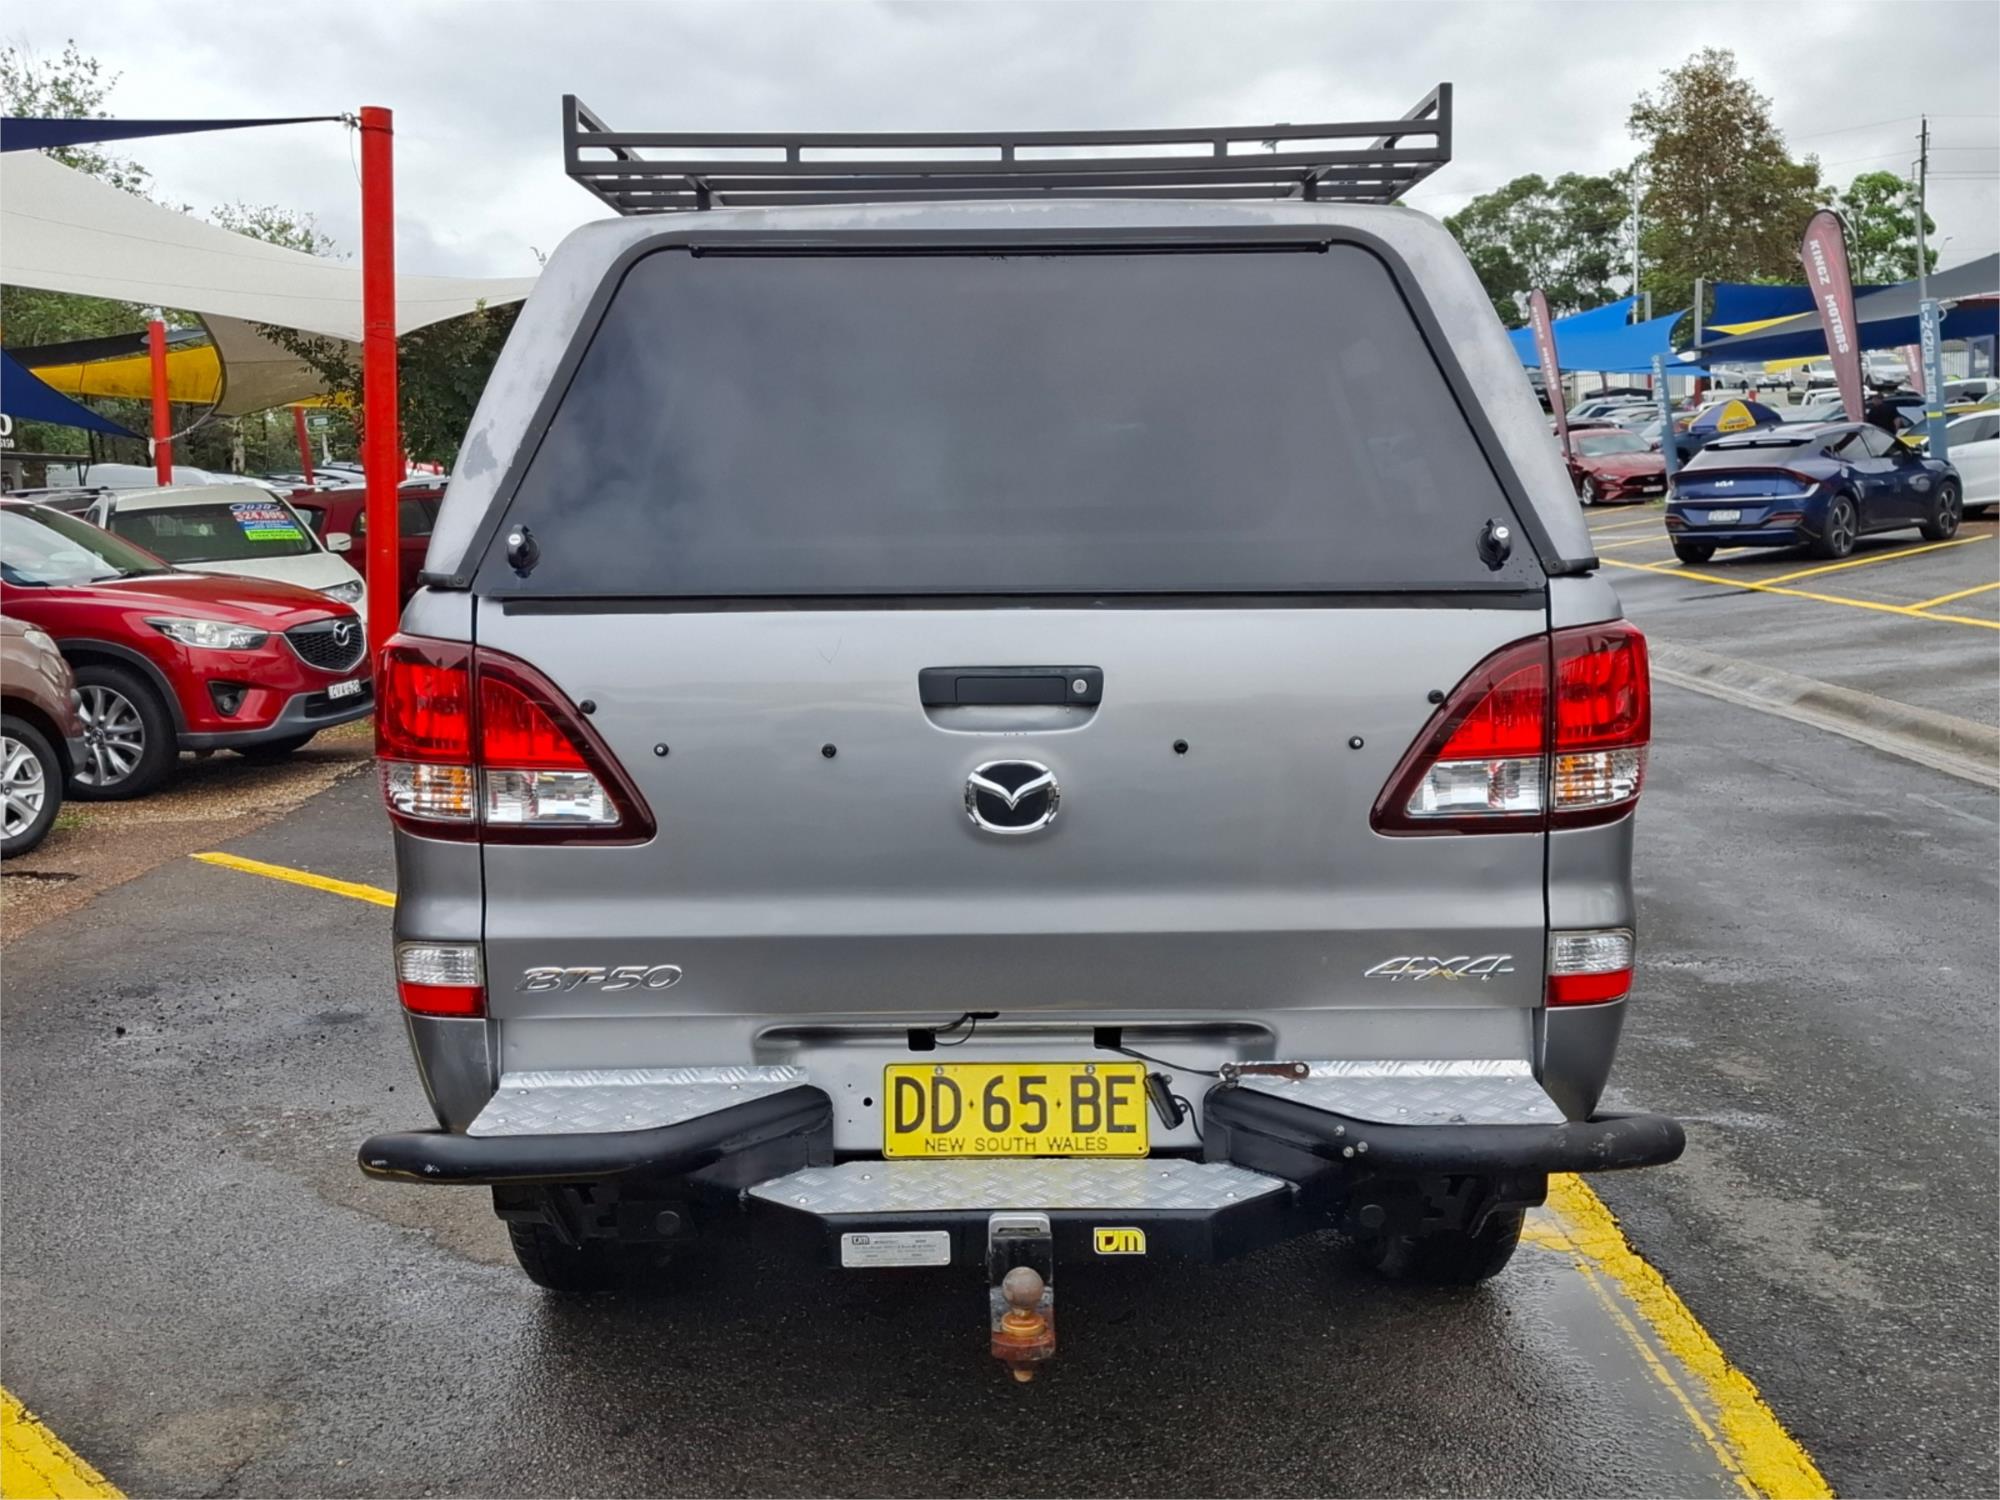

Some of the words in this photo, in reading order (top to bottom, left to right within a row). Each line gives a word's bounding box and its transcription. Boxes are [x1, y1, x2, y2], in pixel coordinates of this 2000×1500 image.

[1824, 293, 1850, 354] MOTORS
[515, 964, 683, 993] BT-50
[925, 1136, 965, 1153] NEW
[975, 1136, 1037, 1153] SOUTH
[1046, 1136, 1109, 1153] WALES
